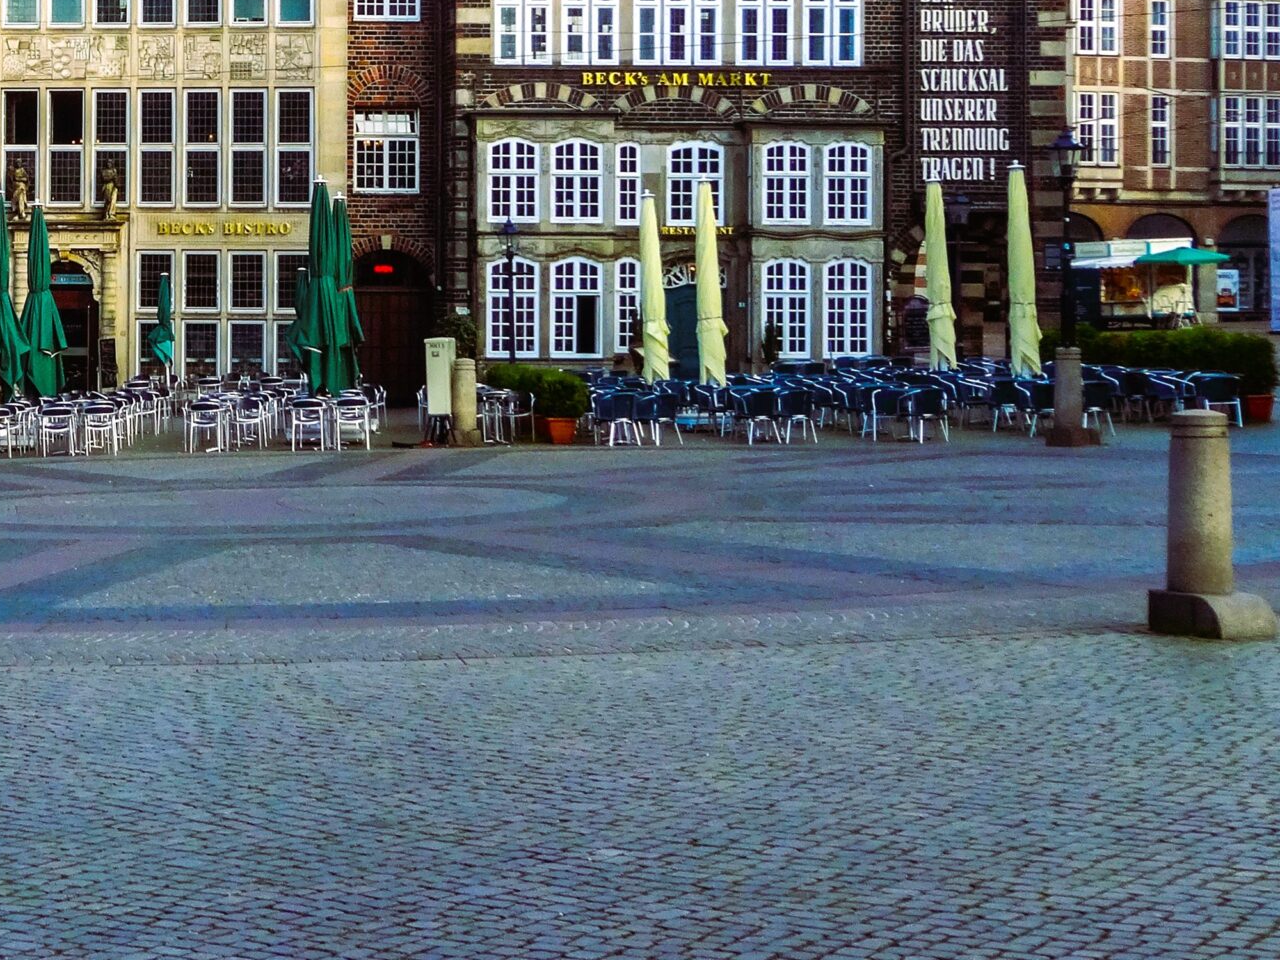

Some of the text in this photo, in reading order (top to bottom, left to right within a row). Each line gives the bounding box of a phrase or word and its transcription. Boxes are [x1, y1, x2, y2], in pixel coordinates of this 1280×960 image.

[920, 6, 997, 34] BRÜDER,
[920, 39, 984, 62] DIE DAS
[581, 72, 772, 86] BECK's AM MARKT
[920, 69, 1009, 92] SCHICKSAL
[920, 98, 997, 122] UNSERER
[920, 127, 1010, 152] TRENNUNG
[223, 222, 292, 236] BISTRO
[661, 226, 734, 235] RESTANT
